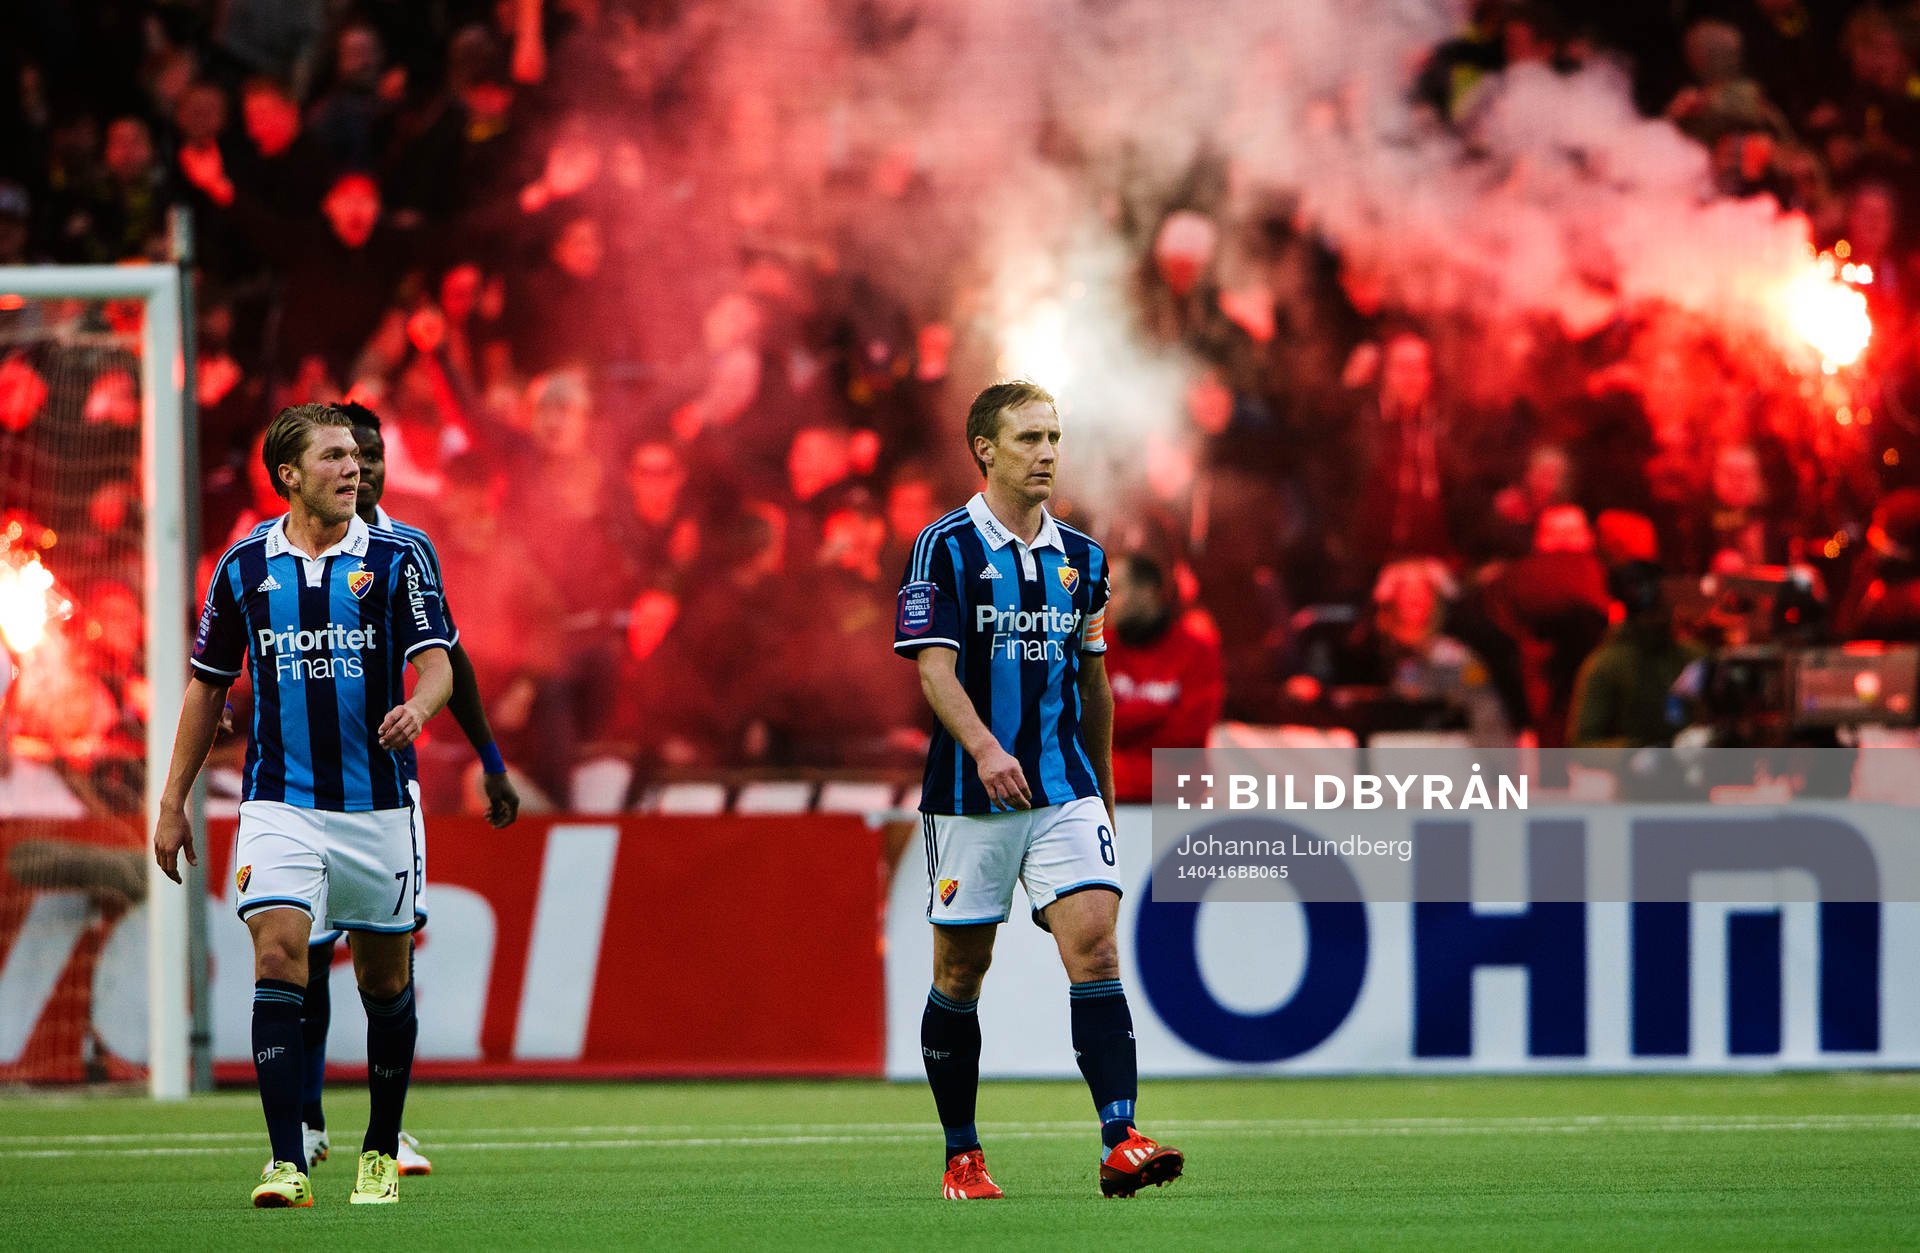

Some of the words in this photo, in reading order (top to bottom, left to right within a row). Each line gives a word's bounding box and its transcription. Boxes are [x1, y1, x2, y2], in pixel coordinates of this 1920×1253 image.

[976, 604, 1081, 633] Prioritet
[258, 623, 377, 656] Prioritet
[990, 633, 1064, 661] Finans
[276, 654, 364, 682] Finans
[1097, 825, 1115, 866] 8
[392, 870, 409, 916] 7
[258, 1047, 285, 1064] DIF
[923, 1046, 951, 1060] DIF
[374, 1064, 403, 1079] DIF
